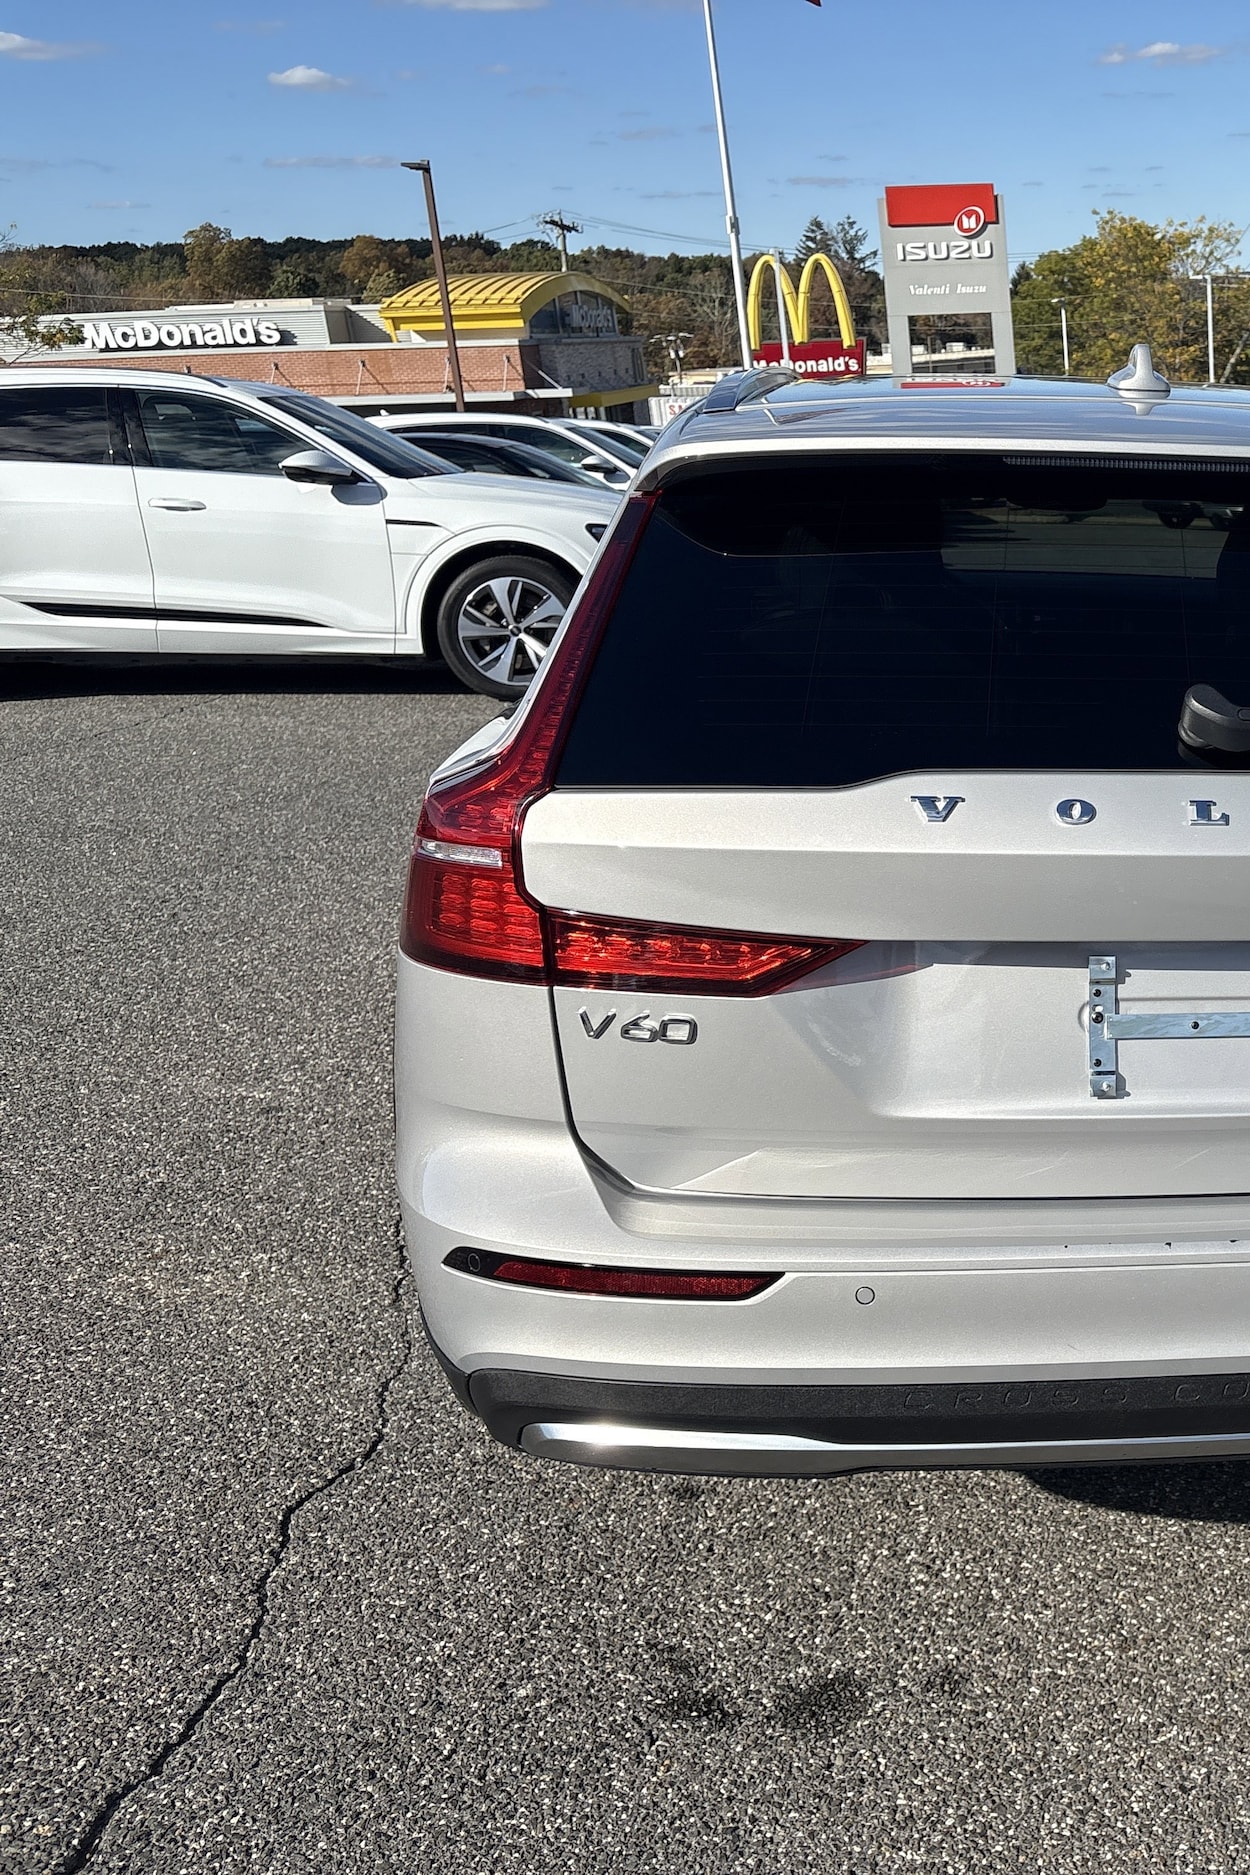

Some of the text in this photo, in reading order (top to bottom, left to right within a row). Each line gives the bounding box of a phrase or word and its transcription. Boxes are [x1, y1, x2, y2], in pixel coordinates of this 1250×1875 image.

[896, 240, 992, 261] ISUZU
[909, 283, 987, 296] Valenti Isuzu
[83, 317, 281, 349] McDonald's
[577, 1006, 698, 1045] V60
[903, 1385, 1129, 1409] CROSS
